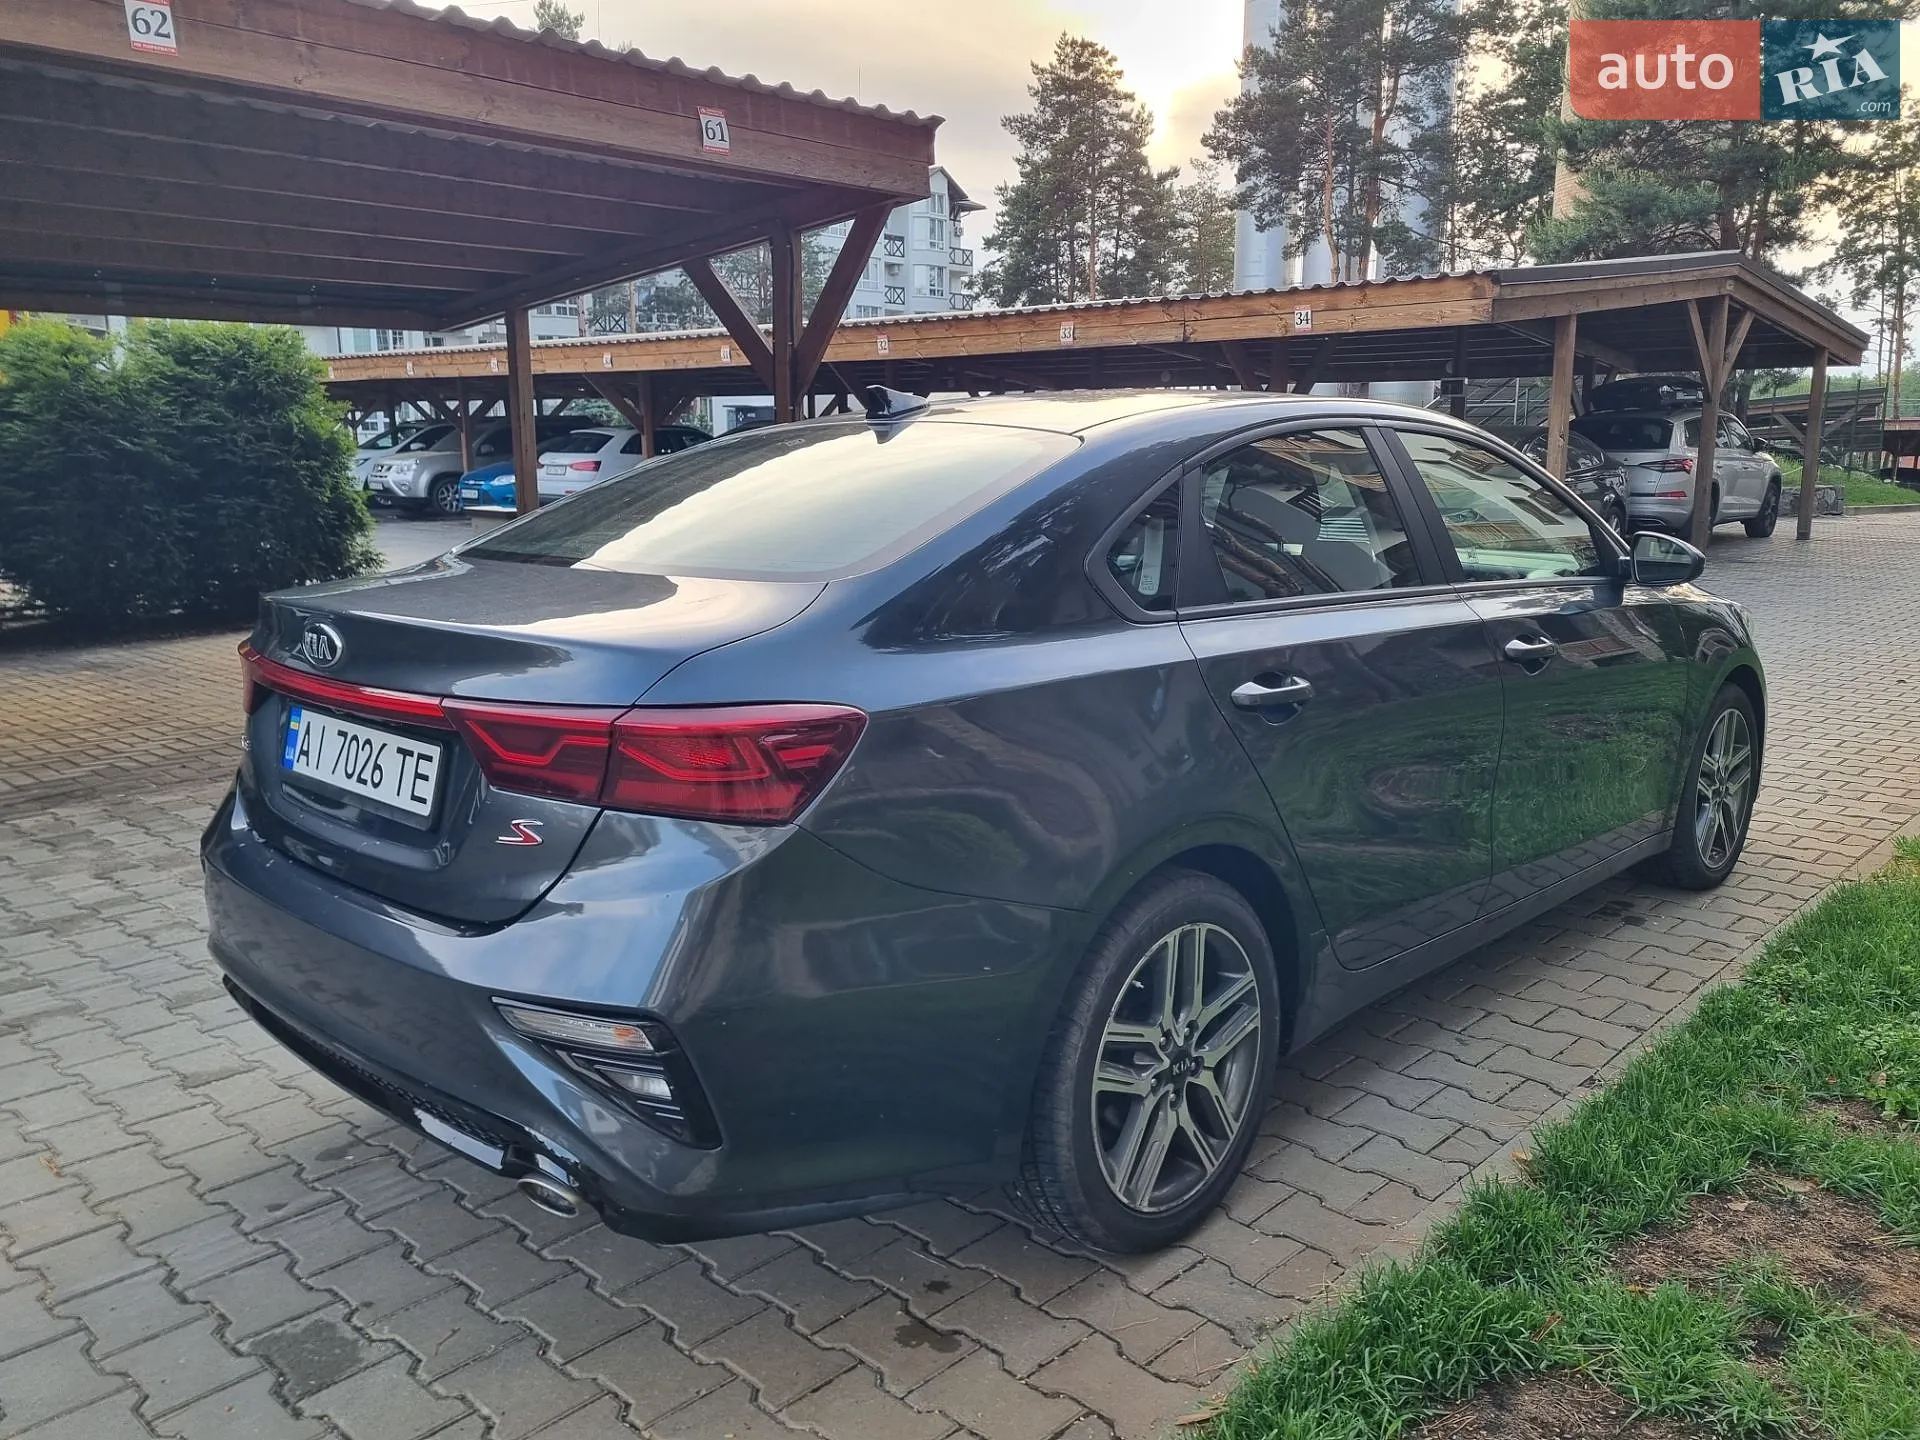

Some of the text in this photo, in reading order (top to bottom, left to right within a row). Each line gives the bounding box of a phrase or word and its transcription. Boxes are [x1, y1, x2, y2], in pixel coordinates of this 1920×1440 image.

[131, 7, 171, 39] 62
[705, 119, 728, 142] 61
[1295, 311, 1311, 326] 34
[1061, 327, 1072, 339] 33
[304, 631, 332, 660] KIA
[331, 729, 388, 789] 7026
[396, 746, 434, 805] TE
